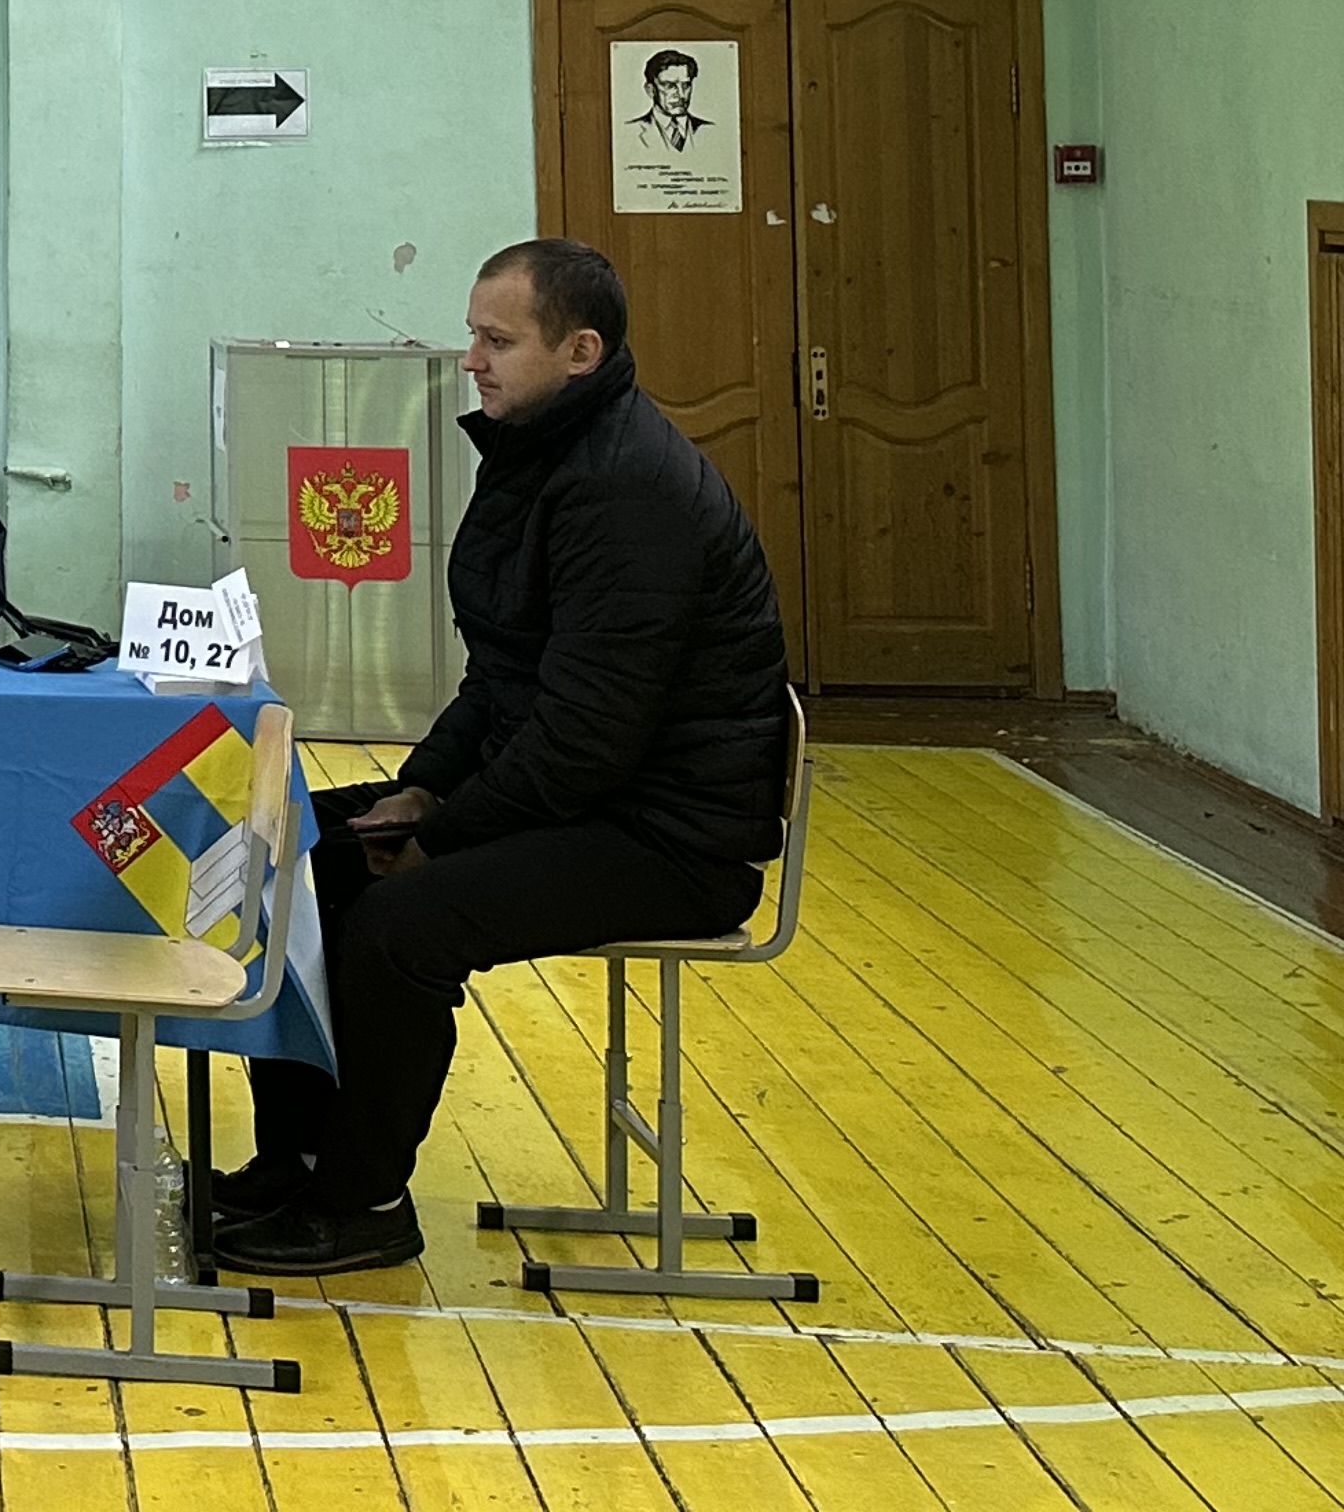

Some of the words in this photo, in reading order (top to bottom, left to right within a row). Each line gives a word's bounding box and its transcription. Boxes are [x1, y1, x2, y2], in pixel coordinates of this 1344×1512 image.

[157, 600, 214, 630] Дом
[129, 641, 150, 659] №
[160, 638, 197, 671] 10,
[206, 643, 240, 668] 27
